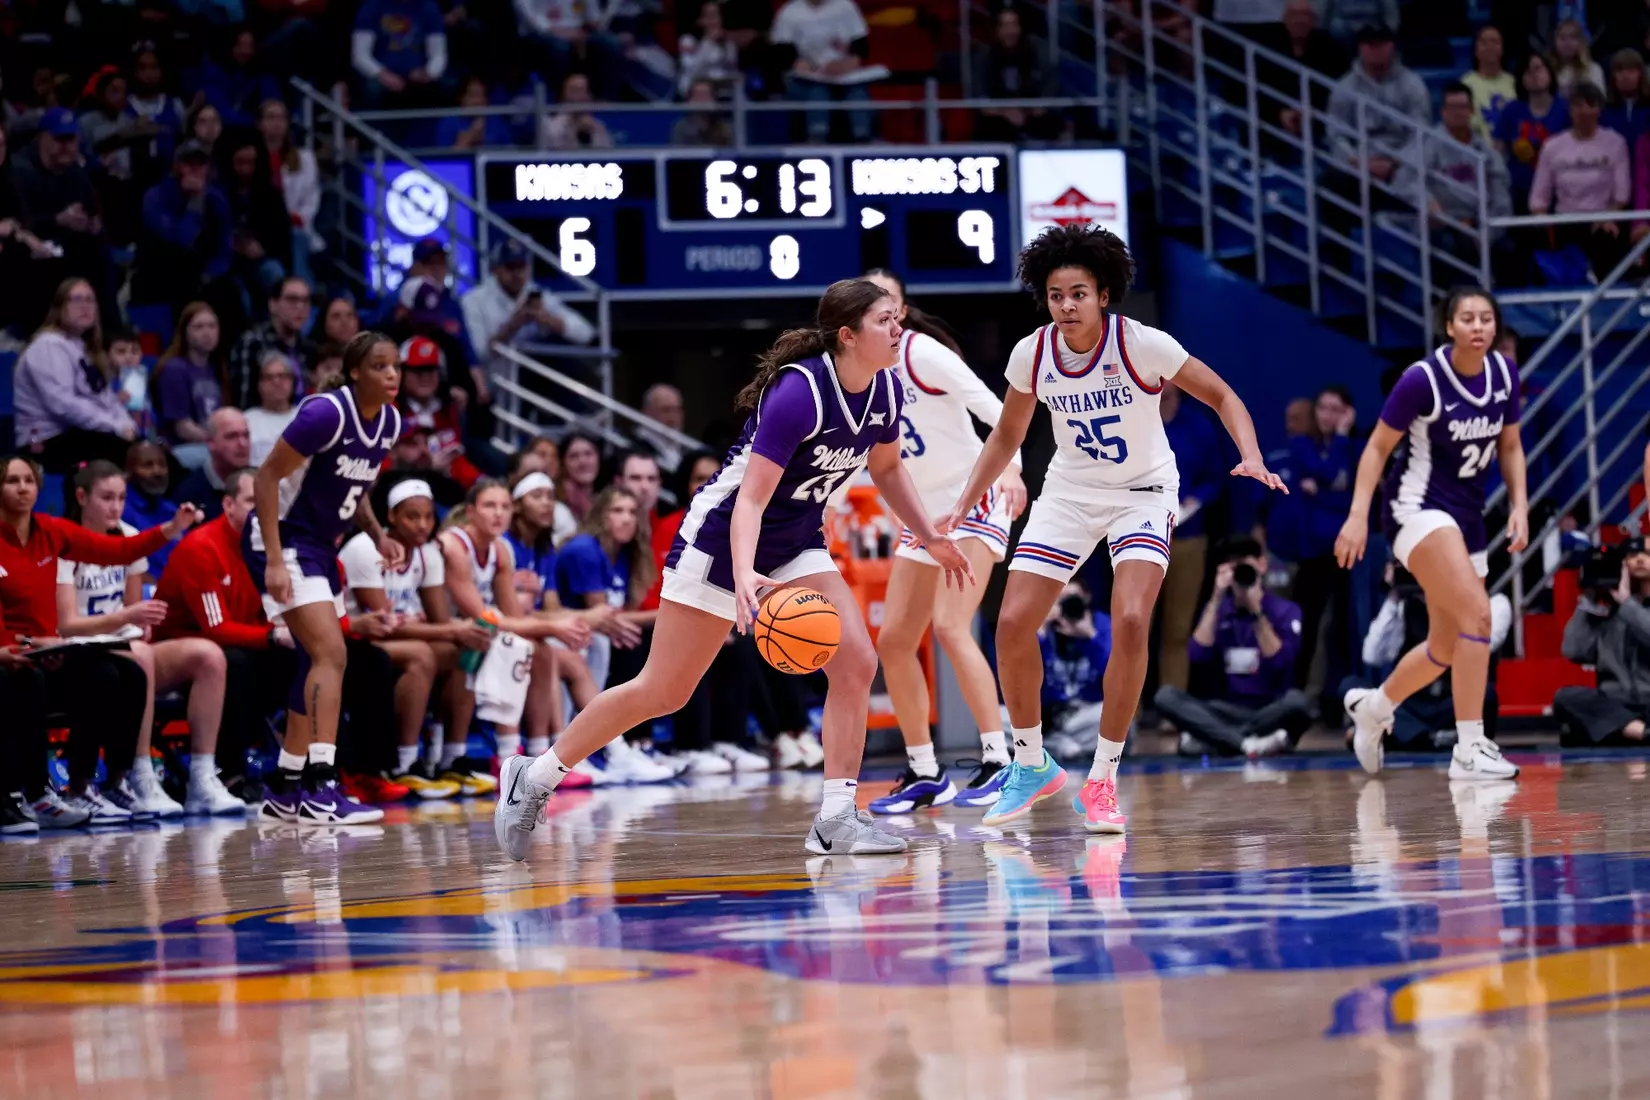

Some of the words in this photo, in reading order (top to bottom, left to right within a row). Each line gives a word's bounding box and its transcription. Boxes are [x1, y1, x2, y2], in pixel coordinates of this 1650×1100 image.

[515, 163, 623, 201] KANSAS
[705, 159, 832, 219] 6:13
[958, 156, 1000, 193] ST
[559, 217, 596, 277] 6
[957, 210, 995, 264] 9
[685, 245, 763, 271] PERIOD
[900, 415, 926, 459] 3
[1066, 414, 1128, 464] 25
[1448, 413, 1504, 441] Wildcat
[334, 454, 382, 481] Wildcat
[809, 444, 870, 471] Wildcat
[338, 486, 363, 520] 5
[790, 471, 845, 503] 23
